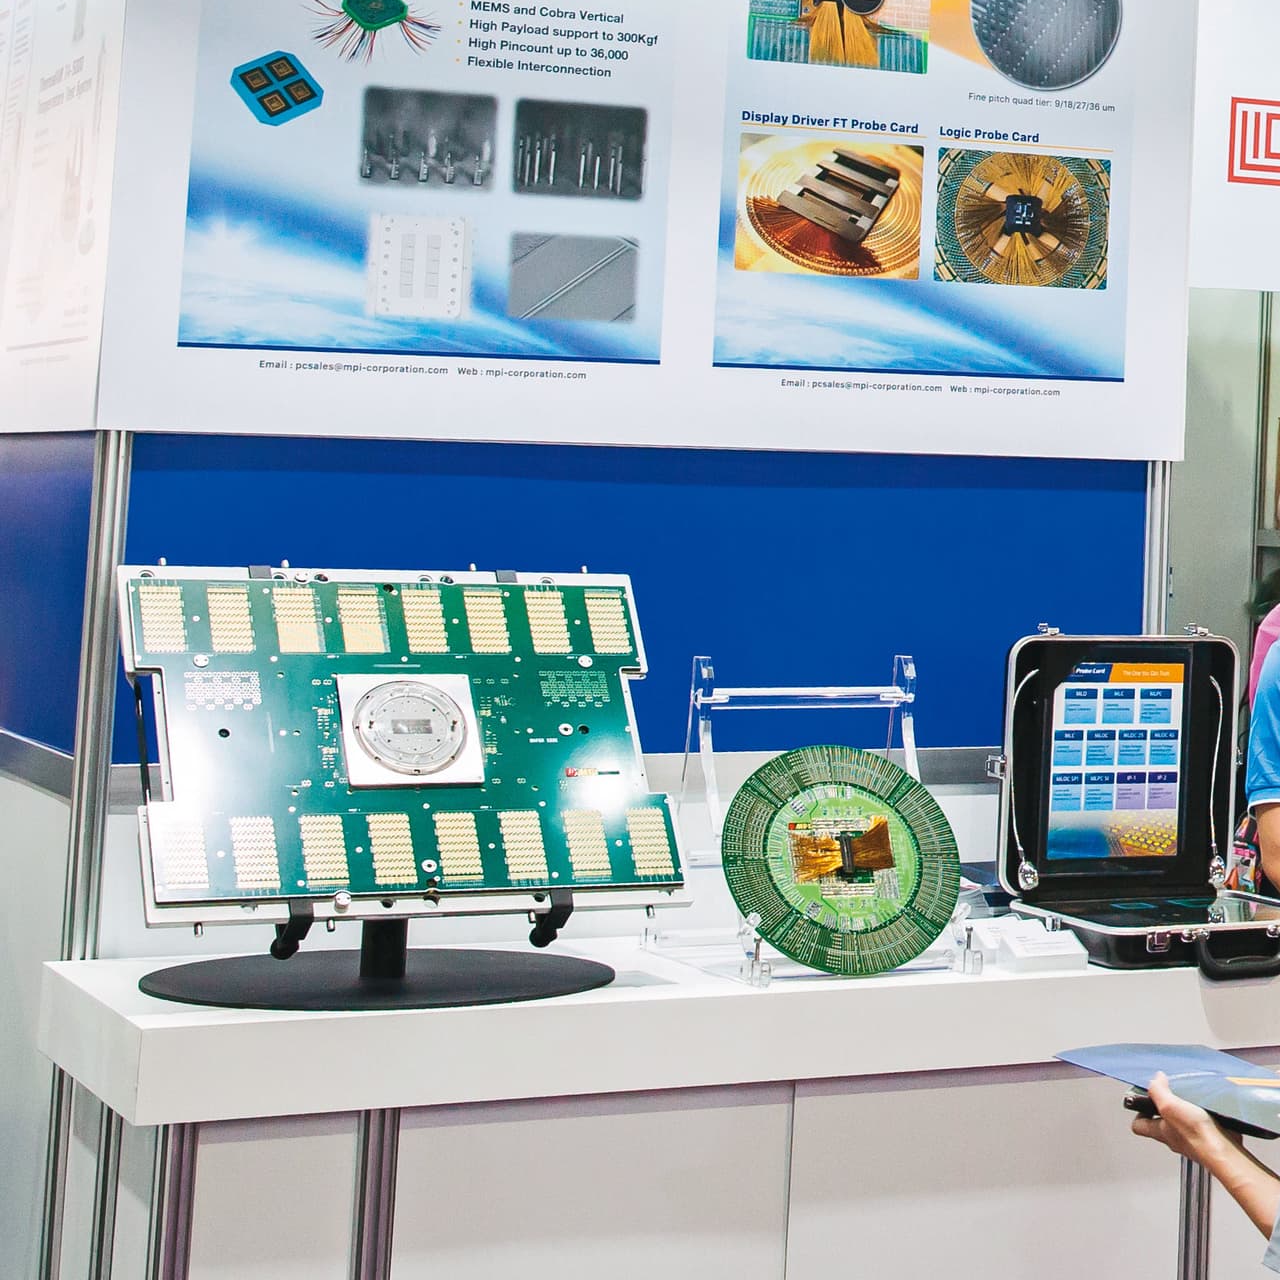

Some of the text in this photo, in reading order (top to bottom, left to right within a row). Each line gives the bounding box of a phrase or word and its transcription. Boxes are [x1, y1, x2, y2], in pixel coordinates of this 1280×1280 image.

[470, 0, 624, 24] MEMS and Cobra Vertical
[469, 19, 497, 33] High
[501, 22, 550, 37] Payload
[552, 28, 599, 41] support
[602, 30, 614, 41] to
[468, 37, 629, 61] High Pincount up to 36,000
[467, 56, 612, 78] Flexible Interconnection
[968, 92, 987, 103] Fine
[989, 93, 1010, 106] pitch
[1103, 103, 1115, 112] um
[741, 110, 918, 134] Display Driver FT Probe Card
[940, 126, 1039, 143] Logic Probe Card
[259, 360, 288, 369] Email
[457, 366, 478, 376] Web
[781, 378, 805, 388] Email
[950, 384, 967, 394] Web
